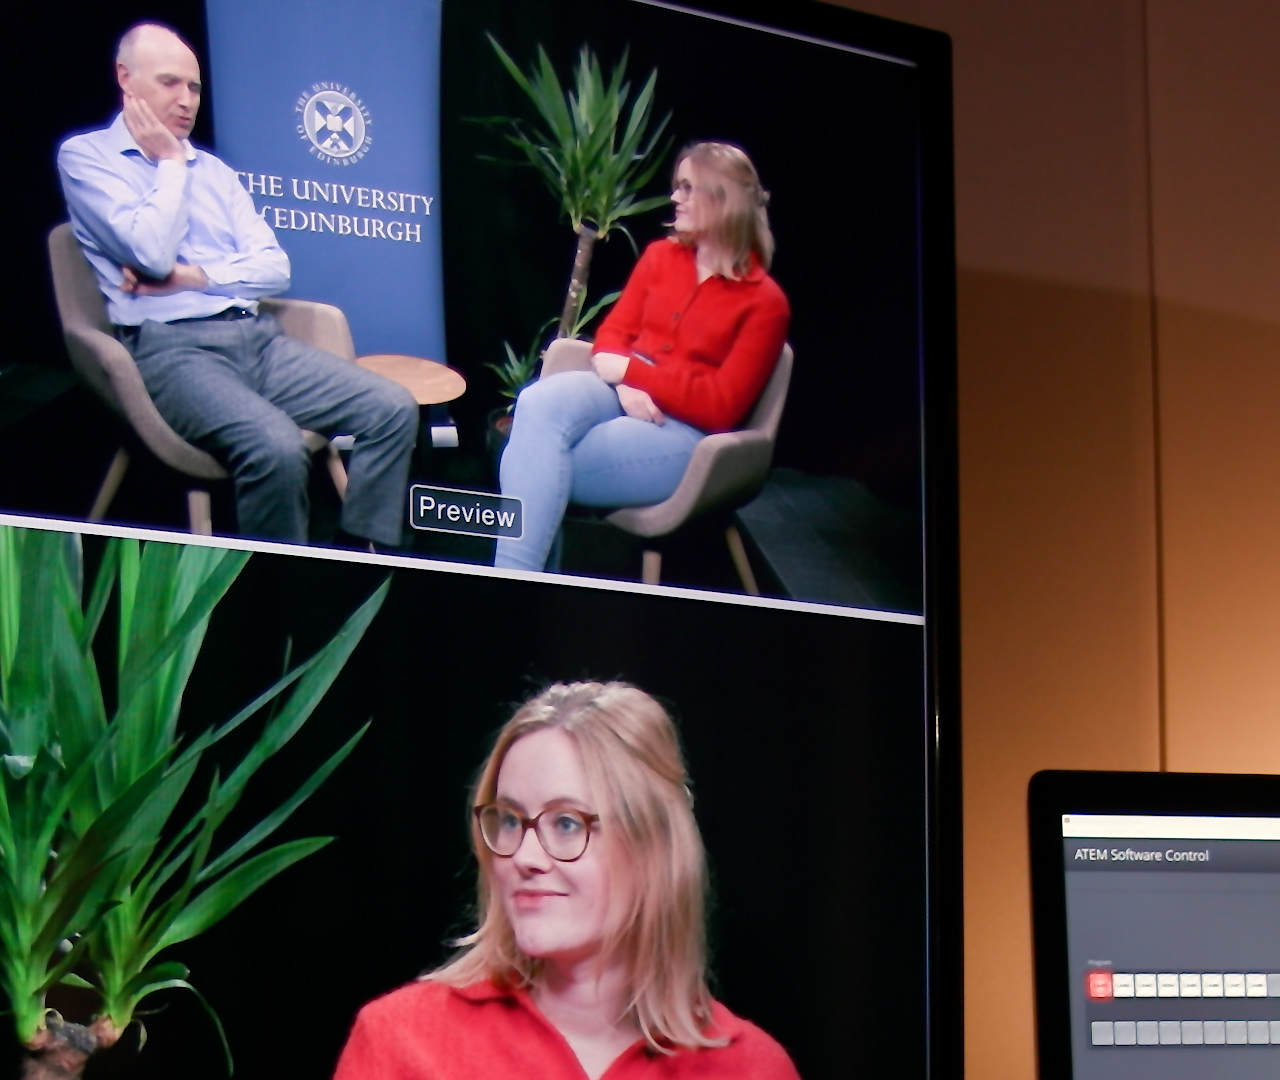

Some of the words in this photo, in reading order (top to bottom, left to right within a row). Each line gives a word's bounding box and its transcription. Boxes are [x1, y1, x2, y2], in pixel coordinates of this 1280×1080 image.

[292, 178, 434, 216] UNIVERSITY
[274, 207, 422, 243] EDINBURGH
[419, 495, 516, 528] Preview
[1074, 848, 1108, 861] ATEM
[1110, 847, 1162, 862] Software
[1165, 849, 1209, 862] Control
